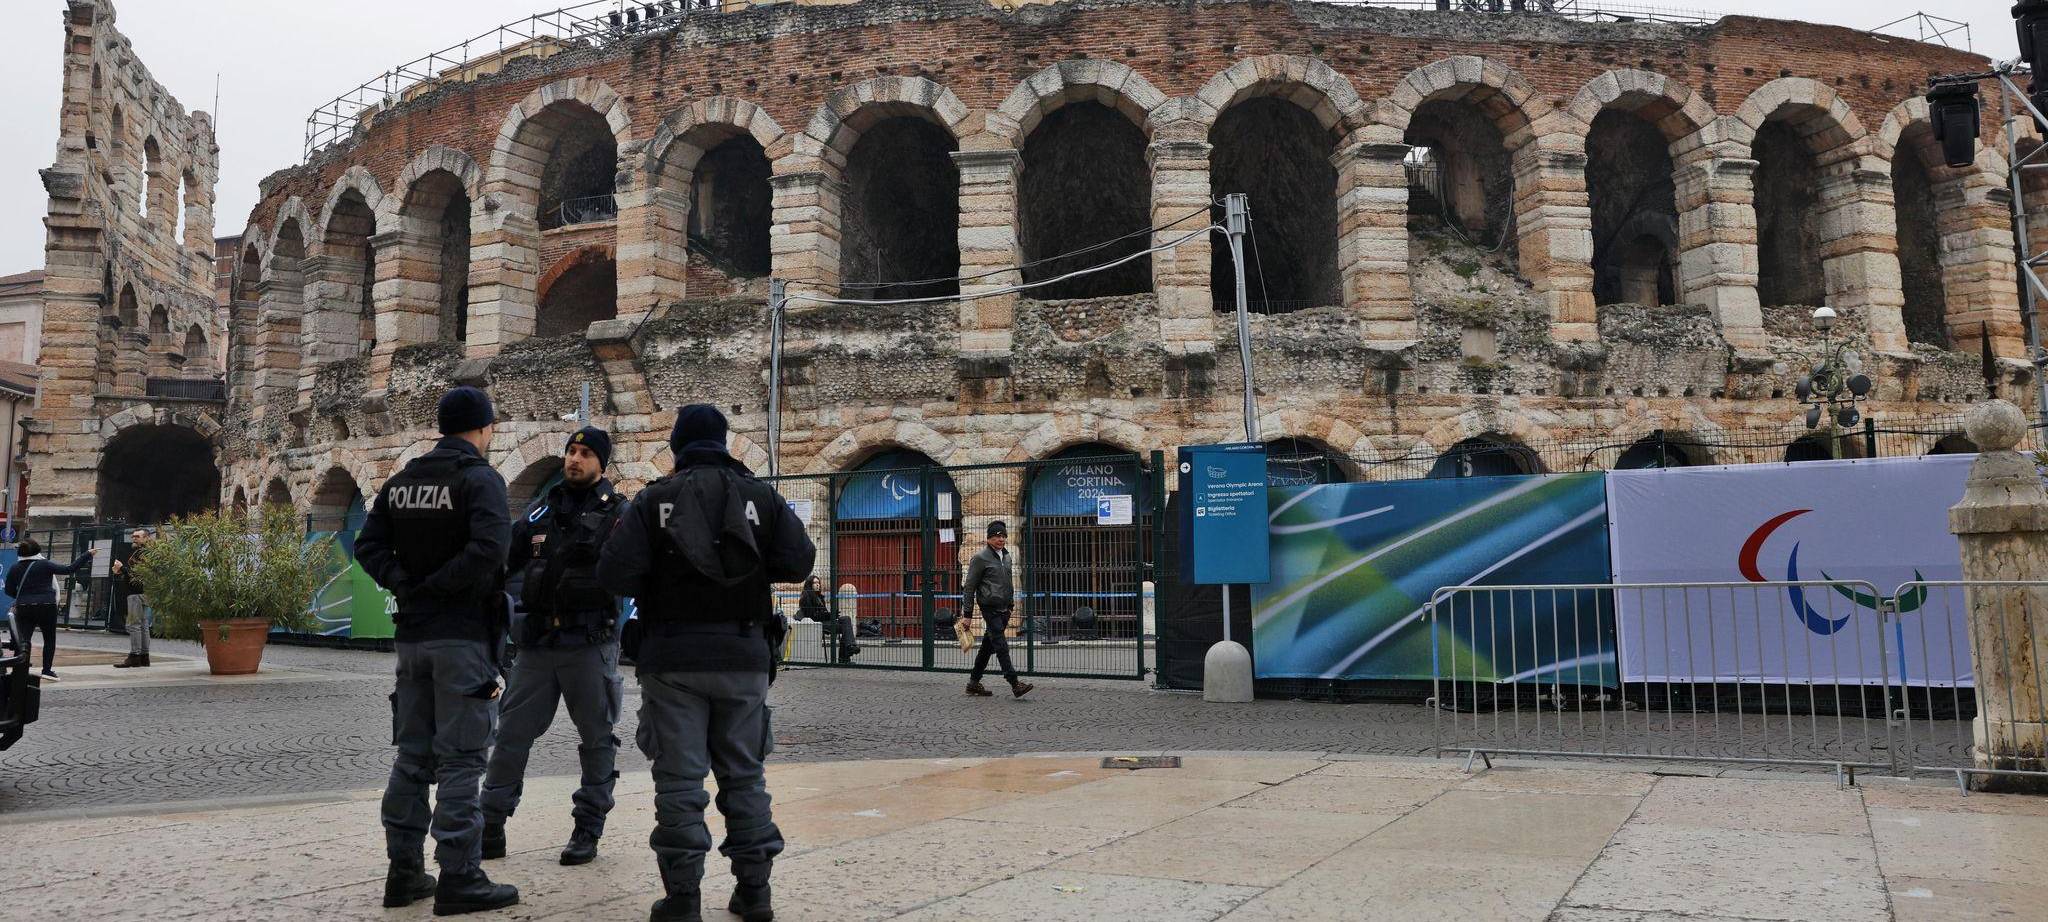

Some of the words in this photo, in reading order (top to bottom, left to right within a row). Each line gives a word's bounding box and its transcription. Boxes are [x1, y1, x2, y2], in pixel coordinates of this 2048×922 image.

[1057, 465, 1114, 475] MILANO
[1067, 477, 1126, 487] CORTINA
[388, 485, 453, 510] POLIZIA
[1078, 488, 1105, 499] 2026
